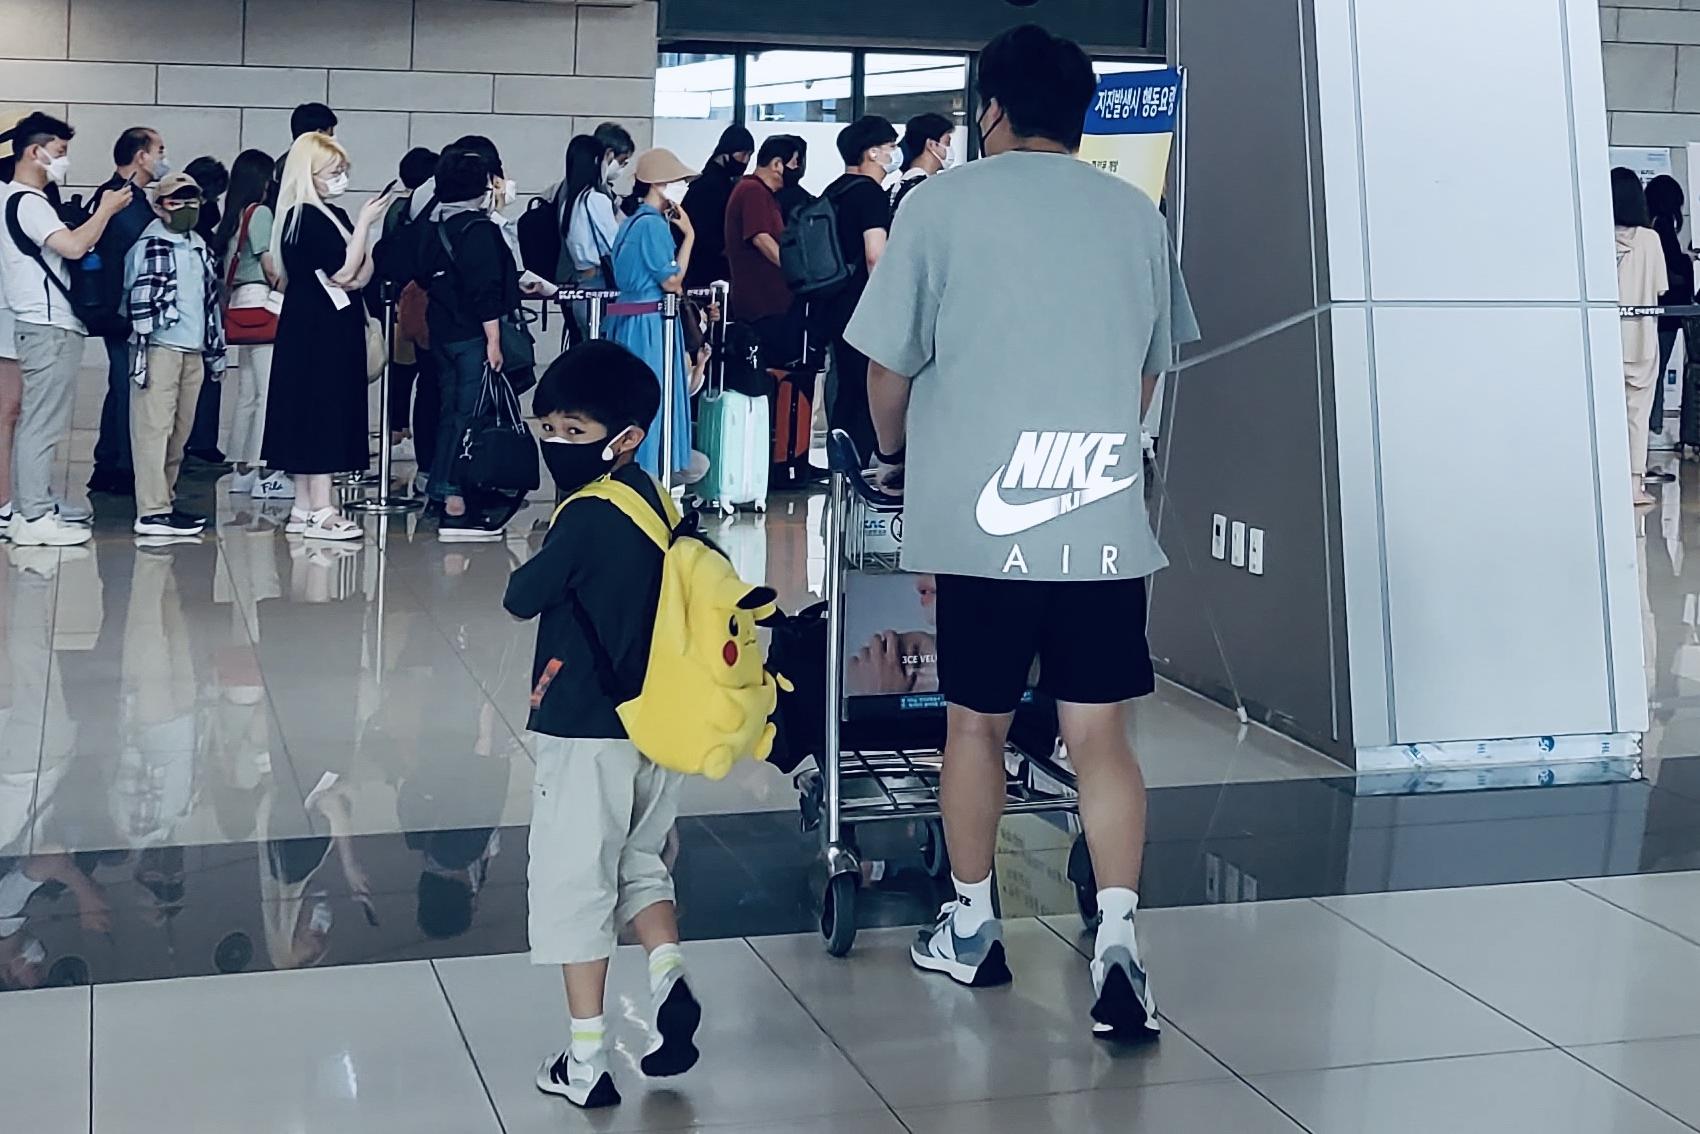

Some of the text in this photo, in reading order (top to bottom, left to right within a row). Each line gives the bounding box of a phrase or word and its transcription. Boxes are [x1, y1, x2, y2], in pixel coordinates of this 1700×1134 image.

[1095, 87, 1140, 119] 지진발생시
[558, 290, 584, 300] KAC
[1001, 431, 1127, 489] NIKE
[1002, 543, 1119, 575] AIR
[901, 655, 918, 664] 3CE
